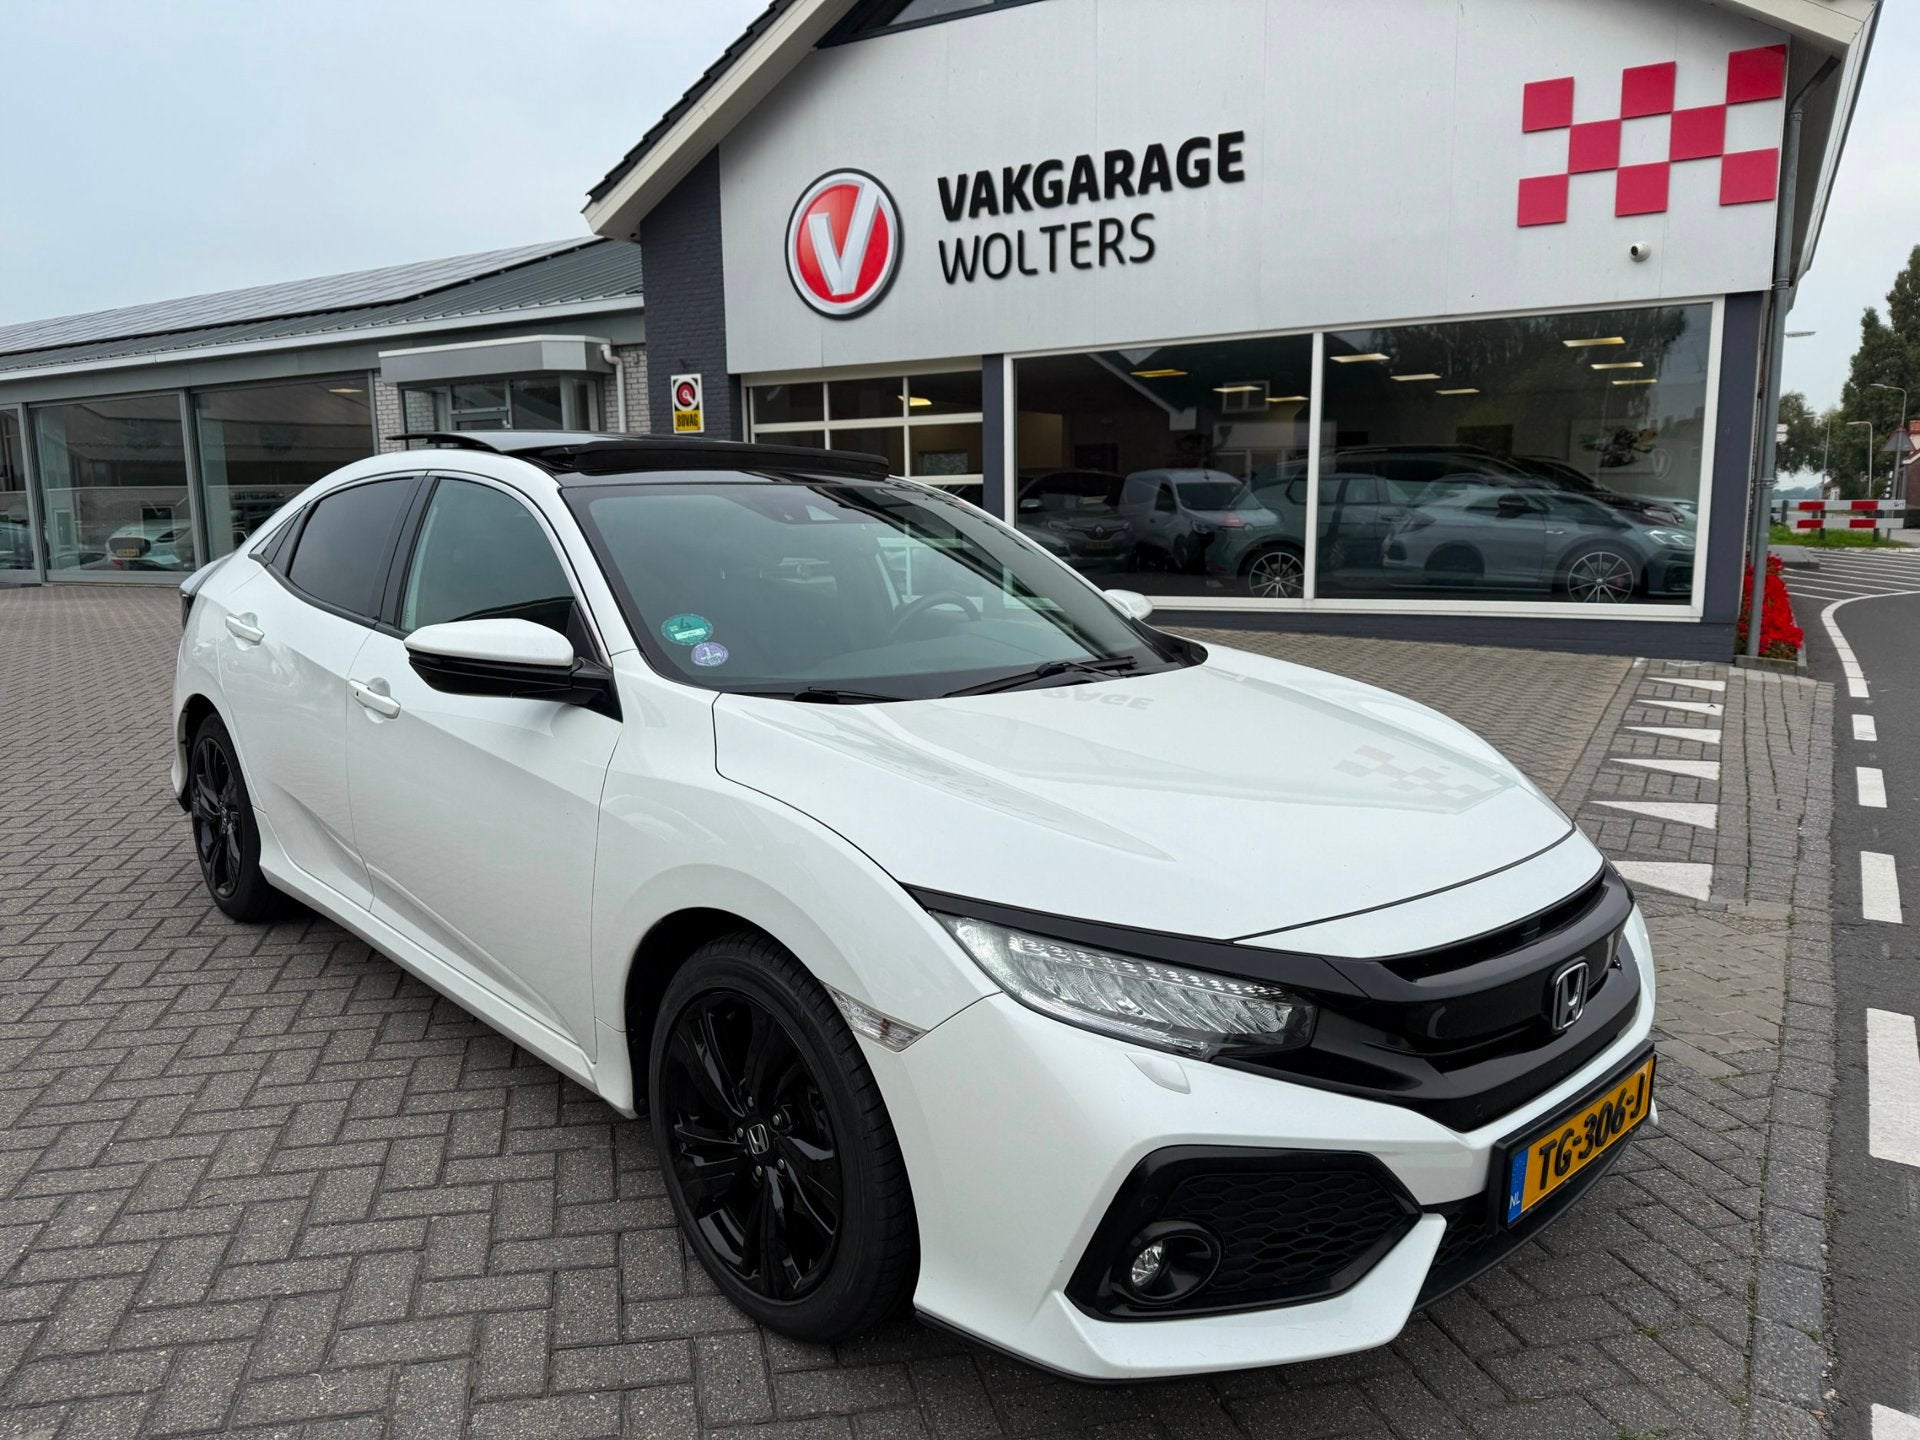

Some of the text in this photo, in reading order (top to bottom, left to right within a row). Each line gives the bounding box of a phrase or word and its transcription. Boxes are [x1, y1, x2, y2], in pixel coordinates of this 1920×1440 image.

[938, 130, 1246, 222] VAKGARAGE
[808, 182, 884, 296] V
[938, 212, 1156, 285] WOLTERS
[676, 413, 699, 428] BOVAG
[1538, 1072, 1646, 1190] TG-306-J
[1508, 1190, 1521, 1210] NL
